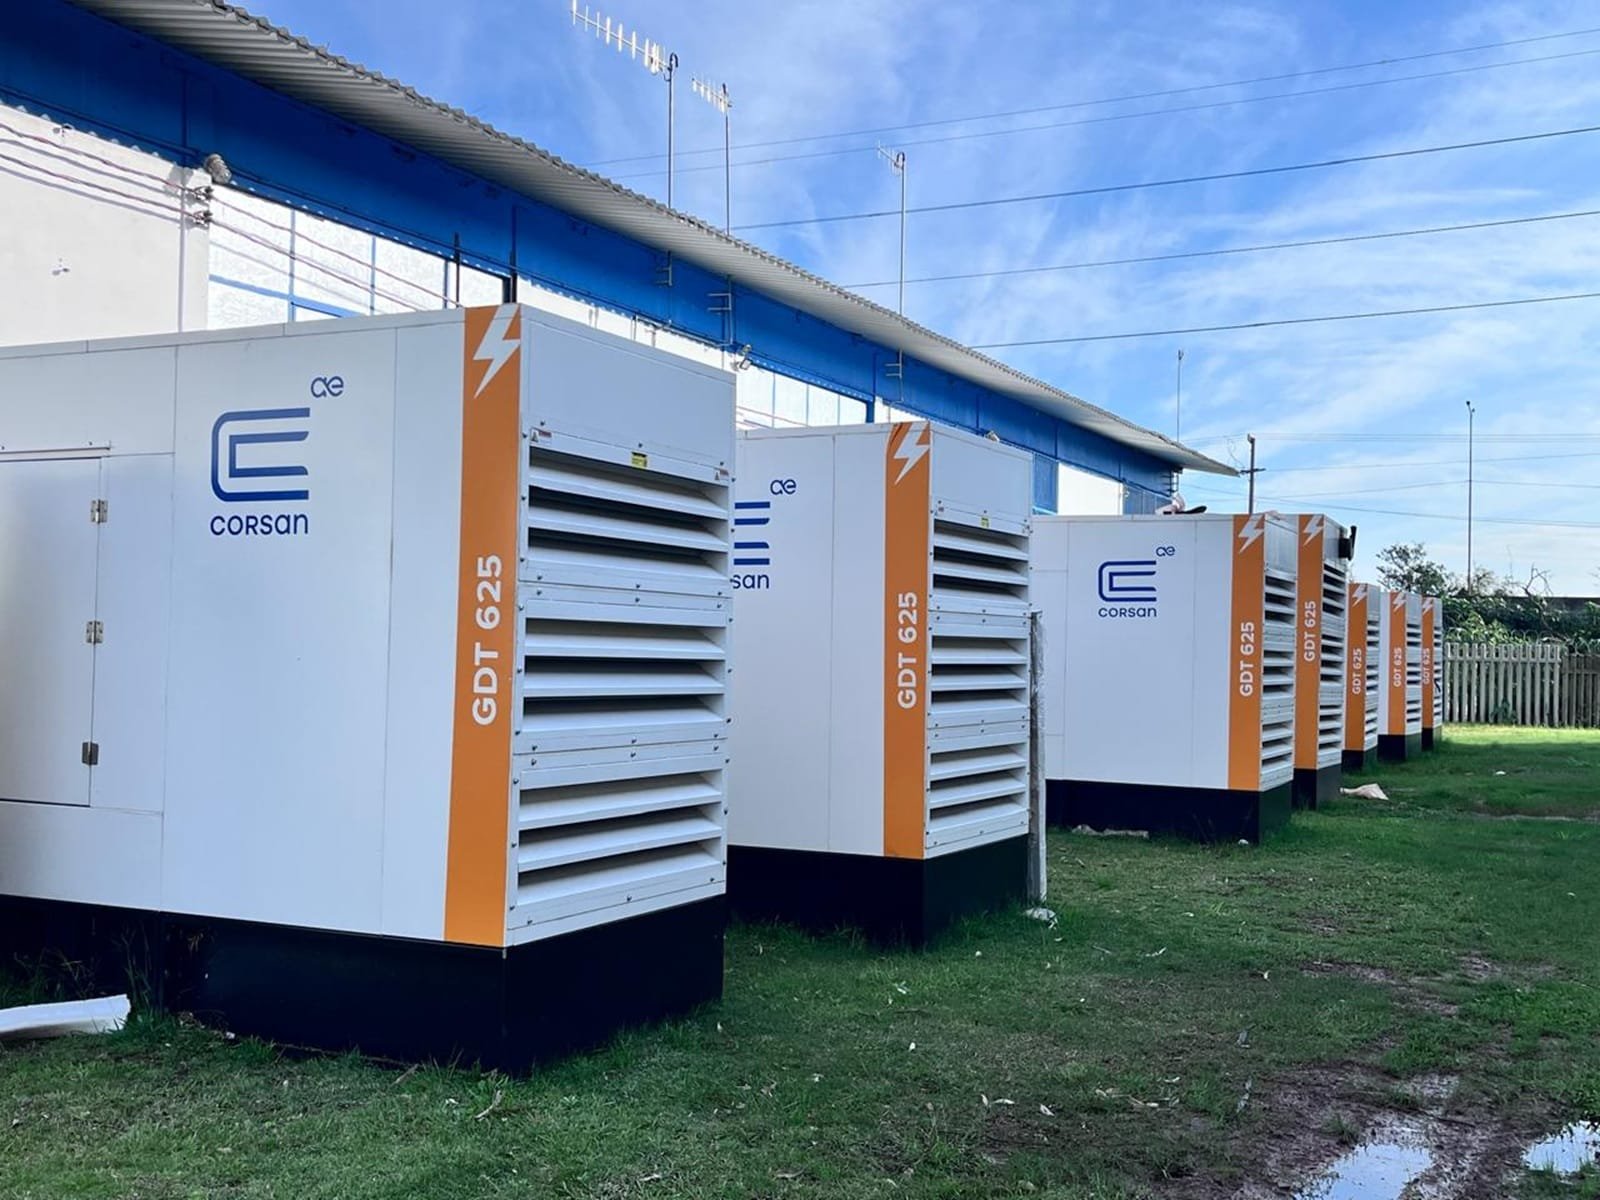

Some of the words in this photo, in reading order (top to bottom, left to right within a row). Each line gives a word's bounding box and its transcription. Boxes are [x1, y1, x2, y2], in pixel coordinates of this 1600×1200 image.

[475, 554, 502, 630] 625
[897, 592, 918, 644] 625
[1304, 600, 1317, 628] 625
[1240, 621, 1255, 656] 625
[1303, 631, 1317, 662] GDT
[1353, 648, 1362, 670] 625
[1394, 647, 1402, 666] 625
[472, 641, 499, 726] GDT
[897, 651, 918, 709] GDT
[1239, 660, 1254, 697] GDT
[1352, 671, 1361, 695] GDT
